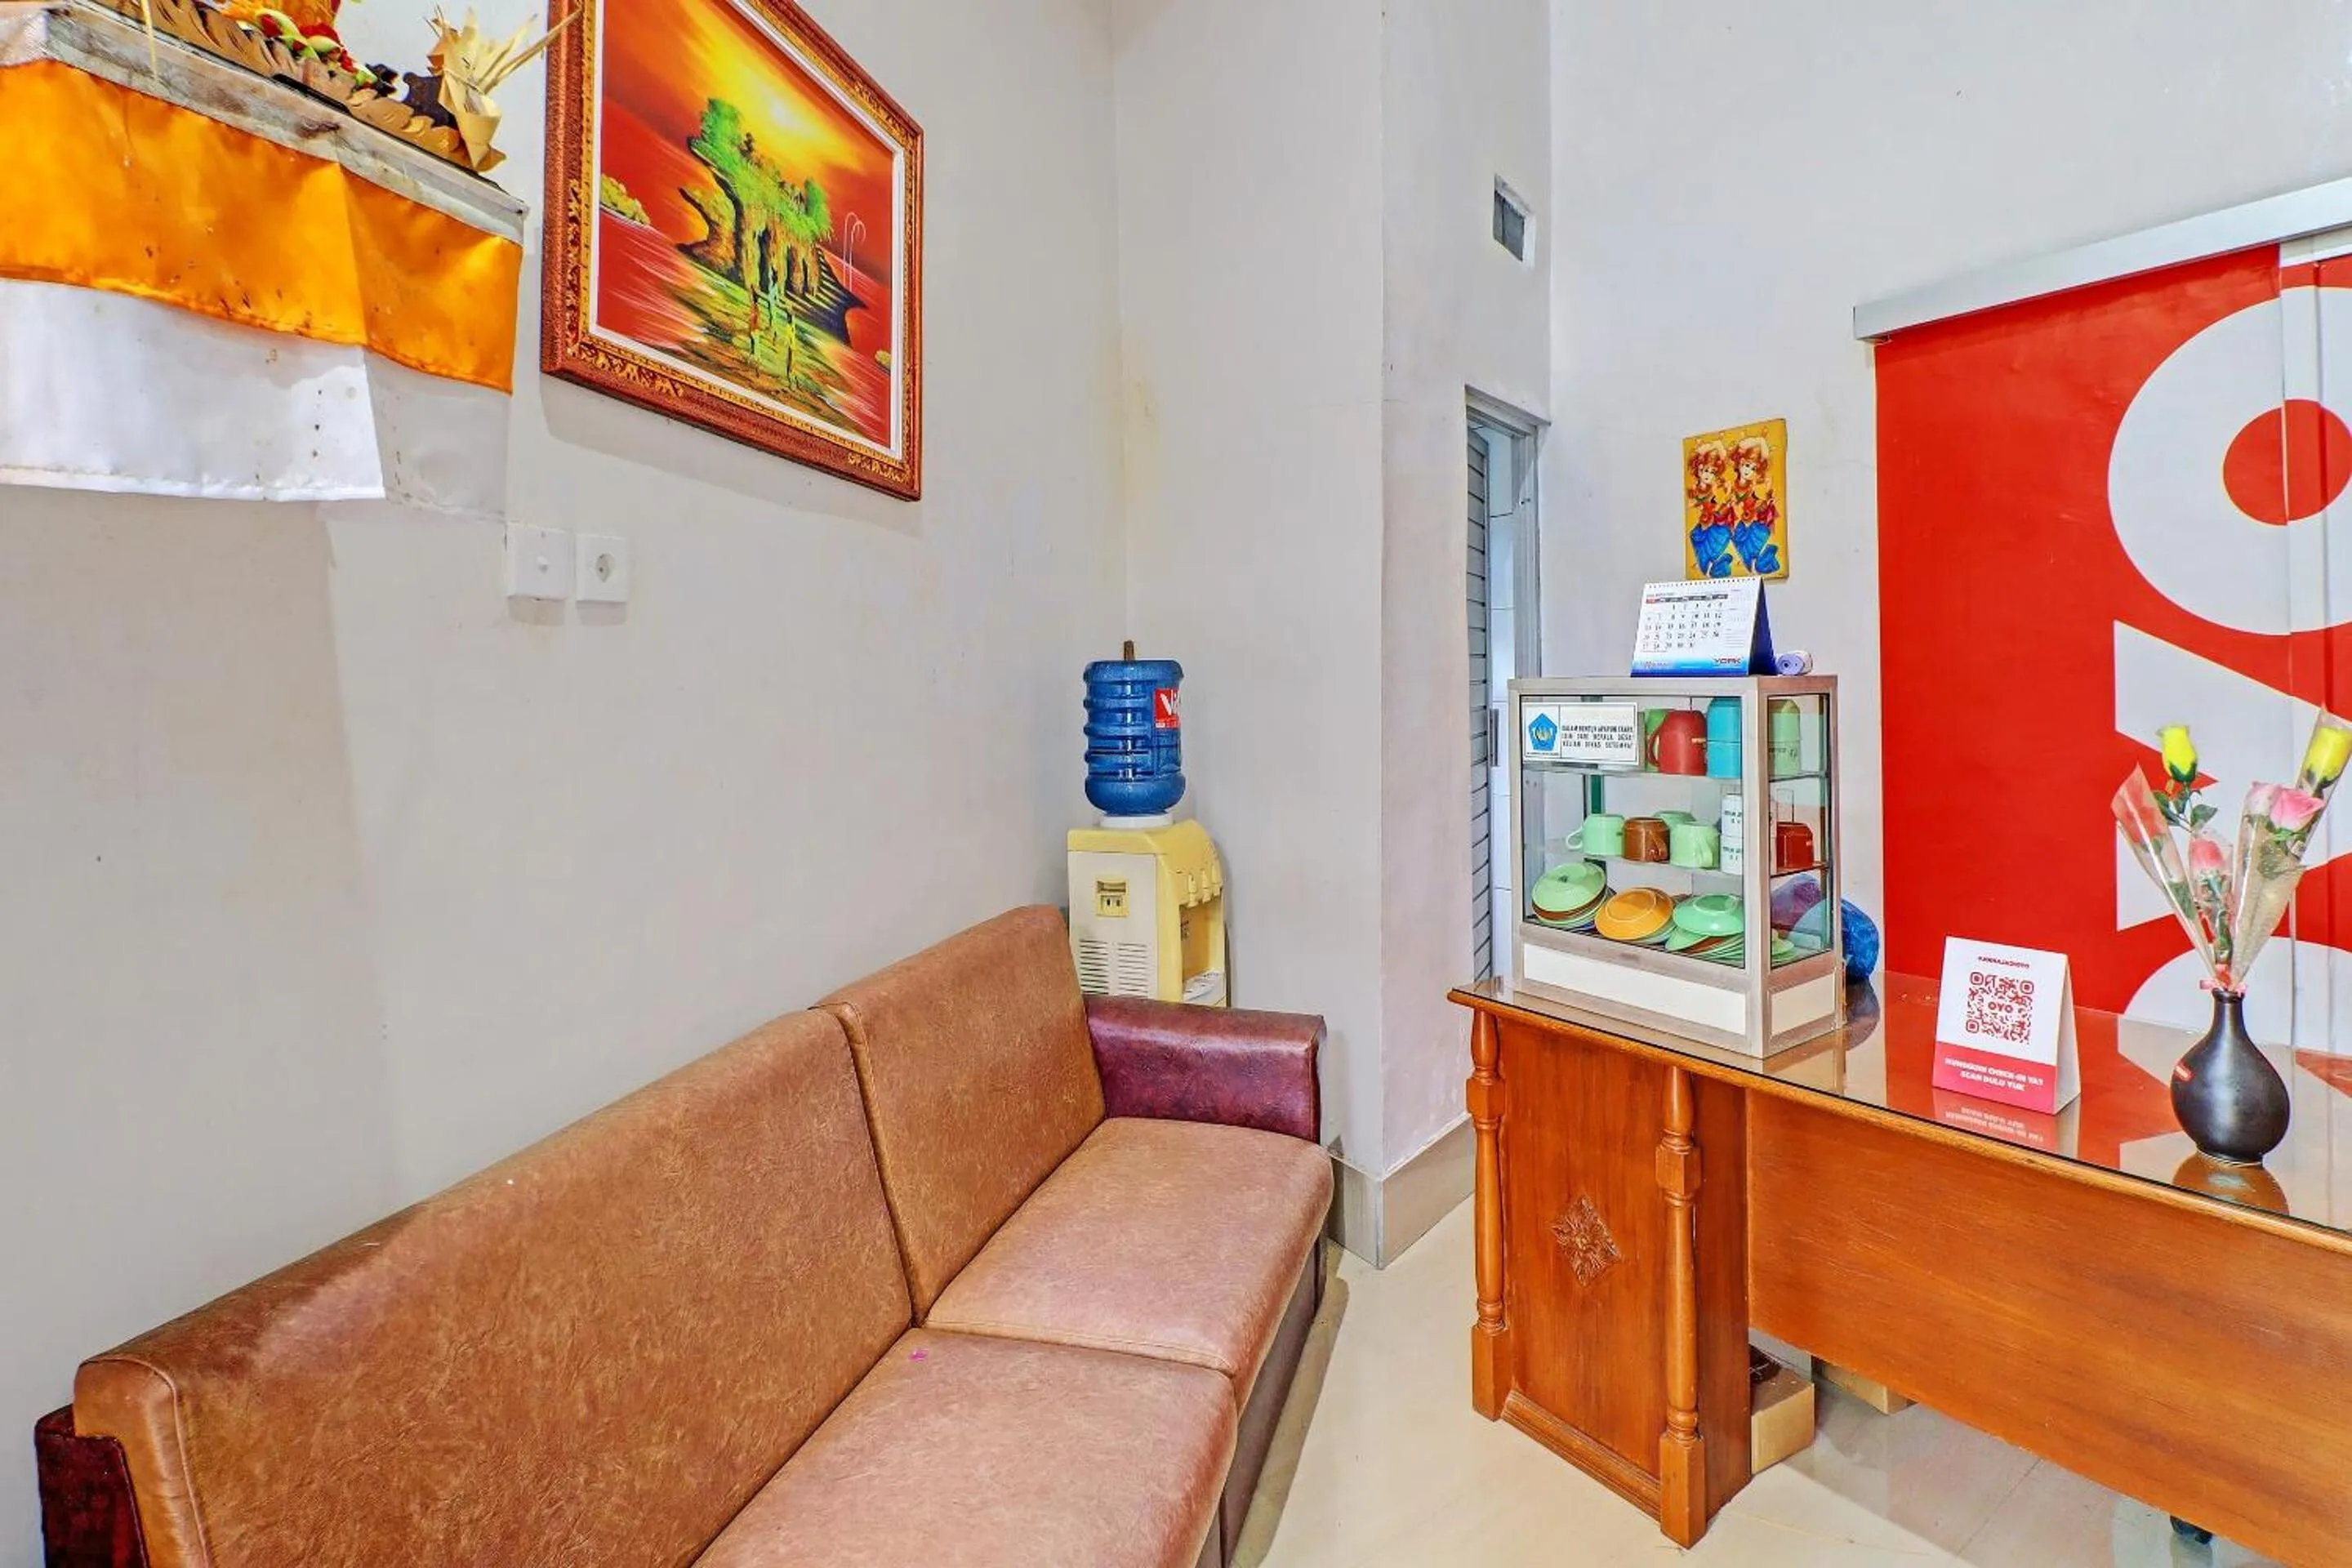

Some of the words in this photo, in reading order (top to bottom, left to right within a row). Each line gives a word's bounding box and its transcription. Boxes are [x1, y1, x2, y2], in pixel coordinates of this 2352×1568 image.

[1988, 1001, 2014, 1013] OYO
[1960, 1071, 1983, 1082] SCAN
[1983, 1075, 2006, 1086] DULU
[2007, 1080, 2025, 1092] YUK
